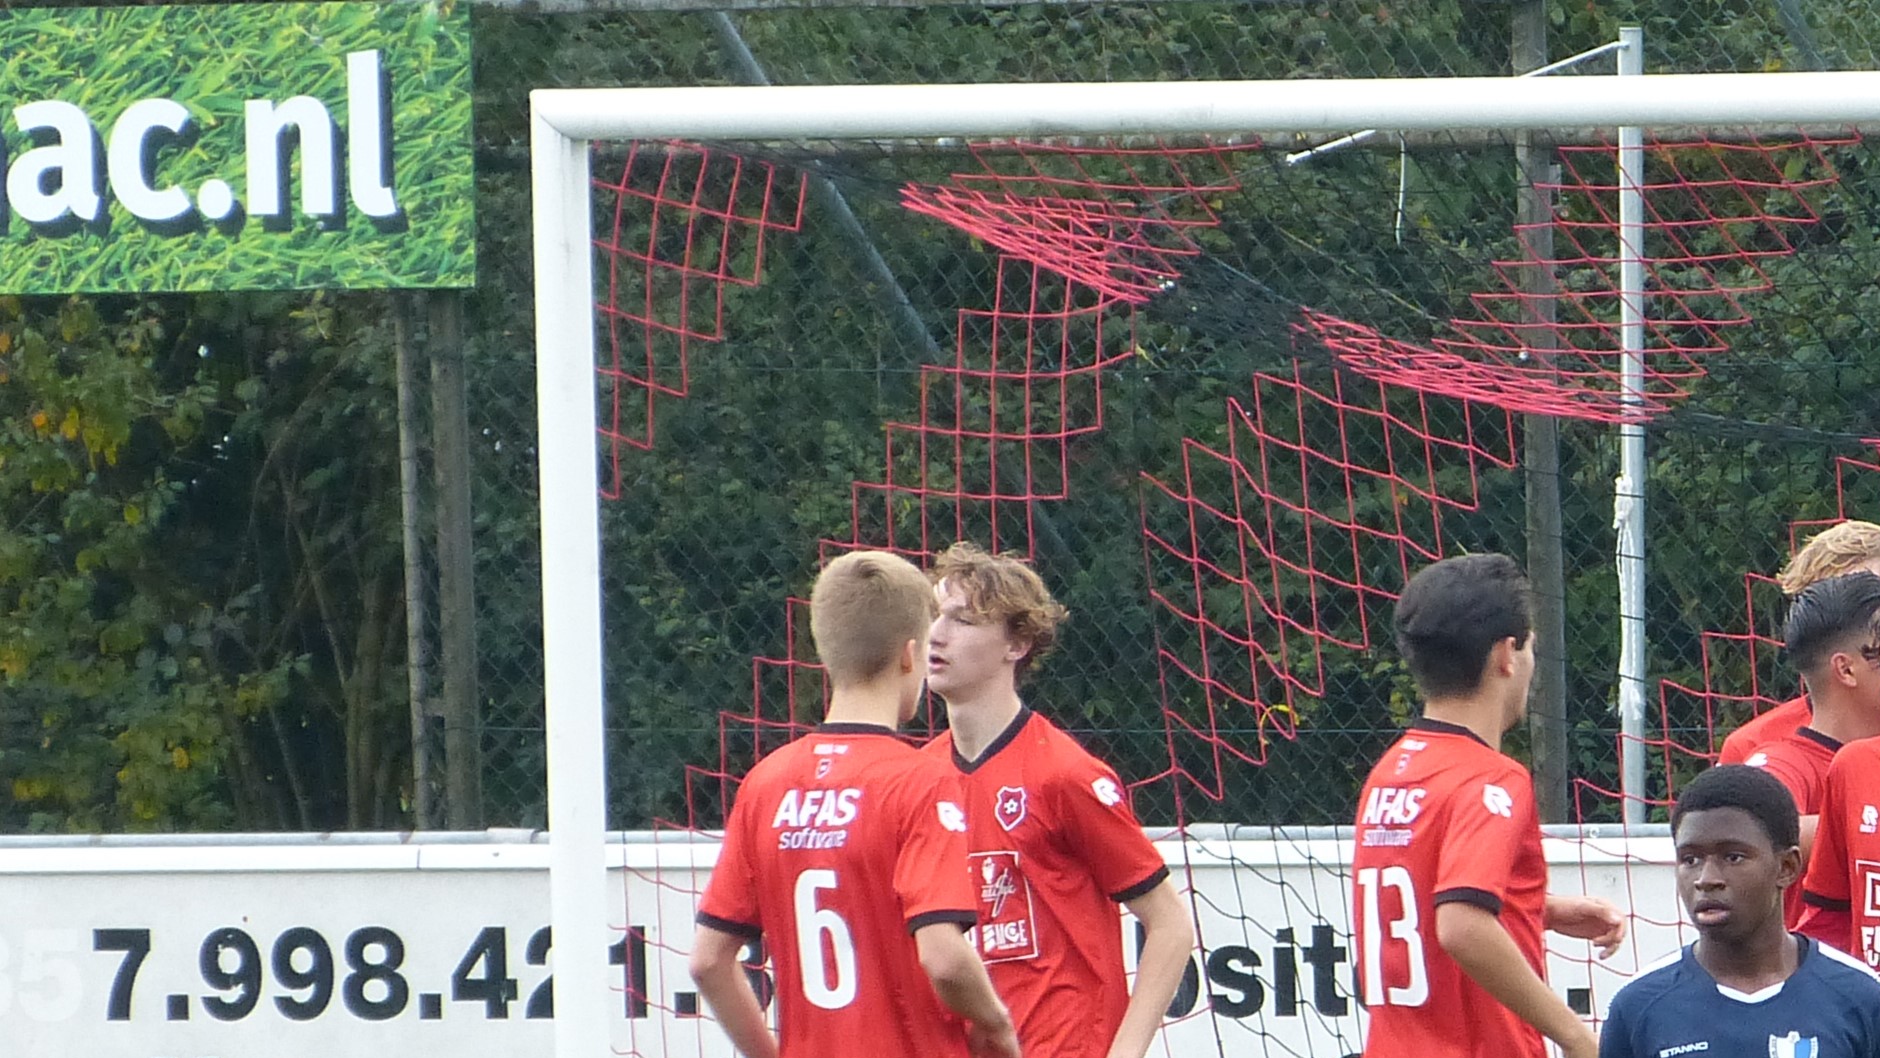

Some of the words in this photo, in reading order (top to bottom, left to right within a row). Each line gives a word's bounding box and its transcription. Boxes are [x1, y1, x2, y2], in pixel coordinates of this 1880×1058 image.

[7, 49, 400, 223] ac.nl
[772, 788, 861, 828] AFAS
[1362, 786, 1427, 825] AFAS
[794, 869, 857, 1010] 6
[1357, 866, 1430, 1007] 13
[1659, 1041, 1709, 1058] STANNO
